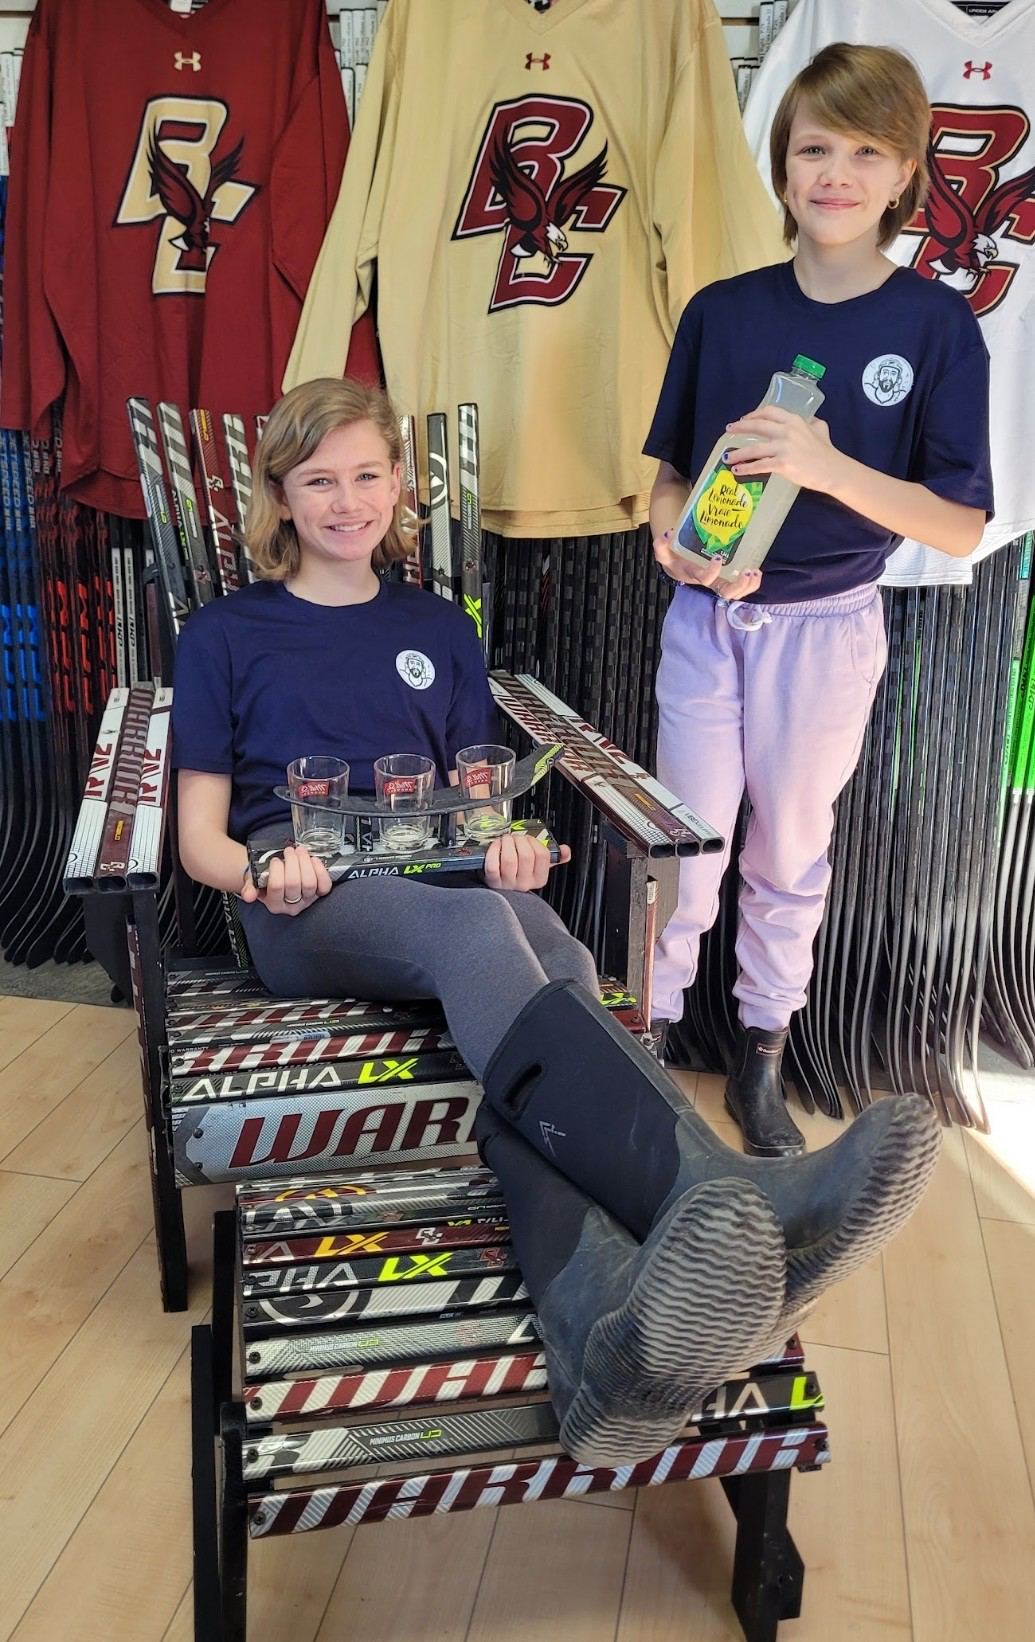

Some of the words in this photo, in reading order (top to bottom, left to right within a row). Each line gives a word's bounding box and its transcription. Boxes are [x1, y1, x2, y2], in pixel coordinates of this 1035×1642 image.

[708, 488, 748, 508] Lemonade
[700, 511, 743, 529] Limonade
[348, 866, 400, 879] ALPHA
[403, 864, 426, 875] LX
[182, 1066, 343, 1101] ALPHA
[357, 1058, 419, 1085] LX
[313, 1231, 391, 1258] LX
[377, 1252, 454, 1282] LX
[369, 1435, 395, 1446] MINIMUS
[395, 1432, 420, 1443] CARBON
